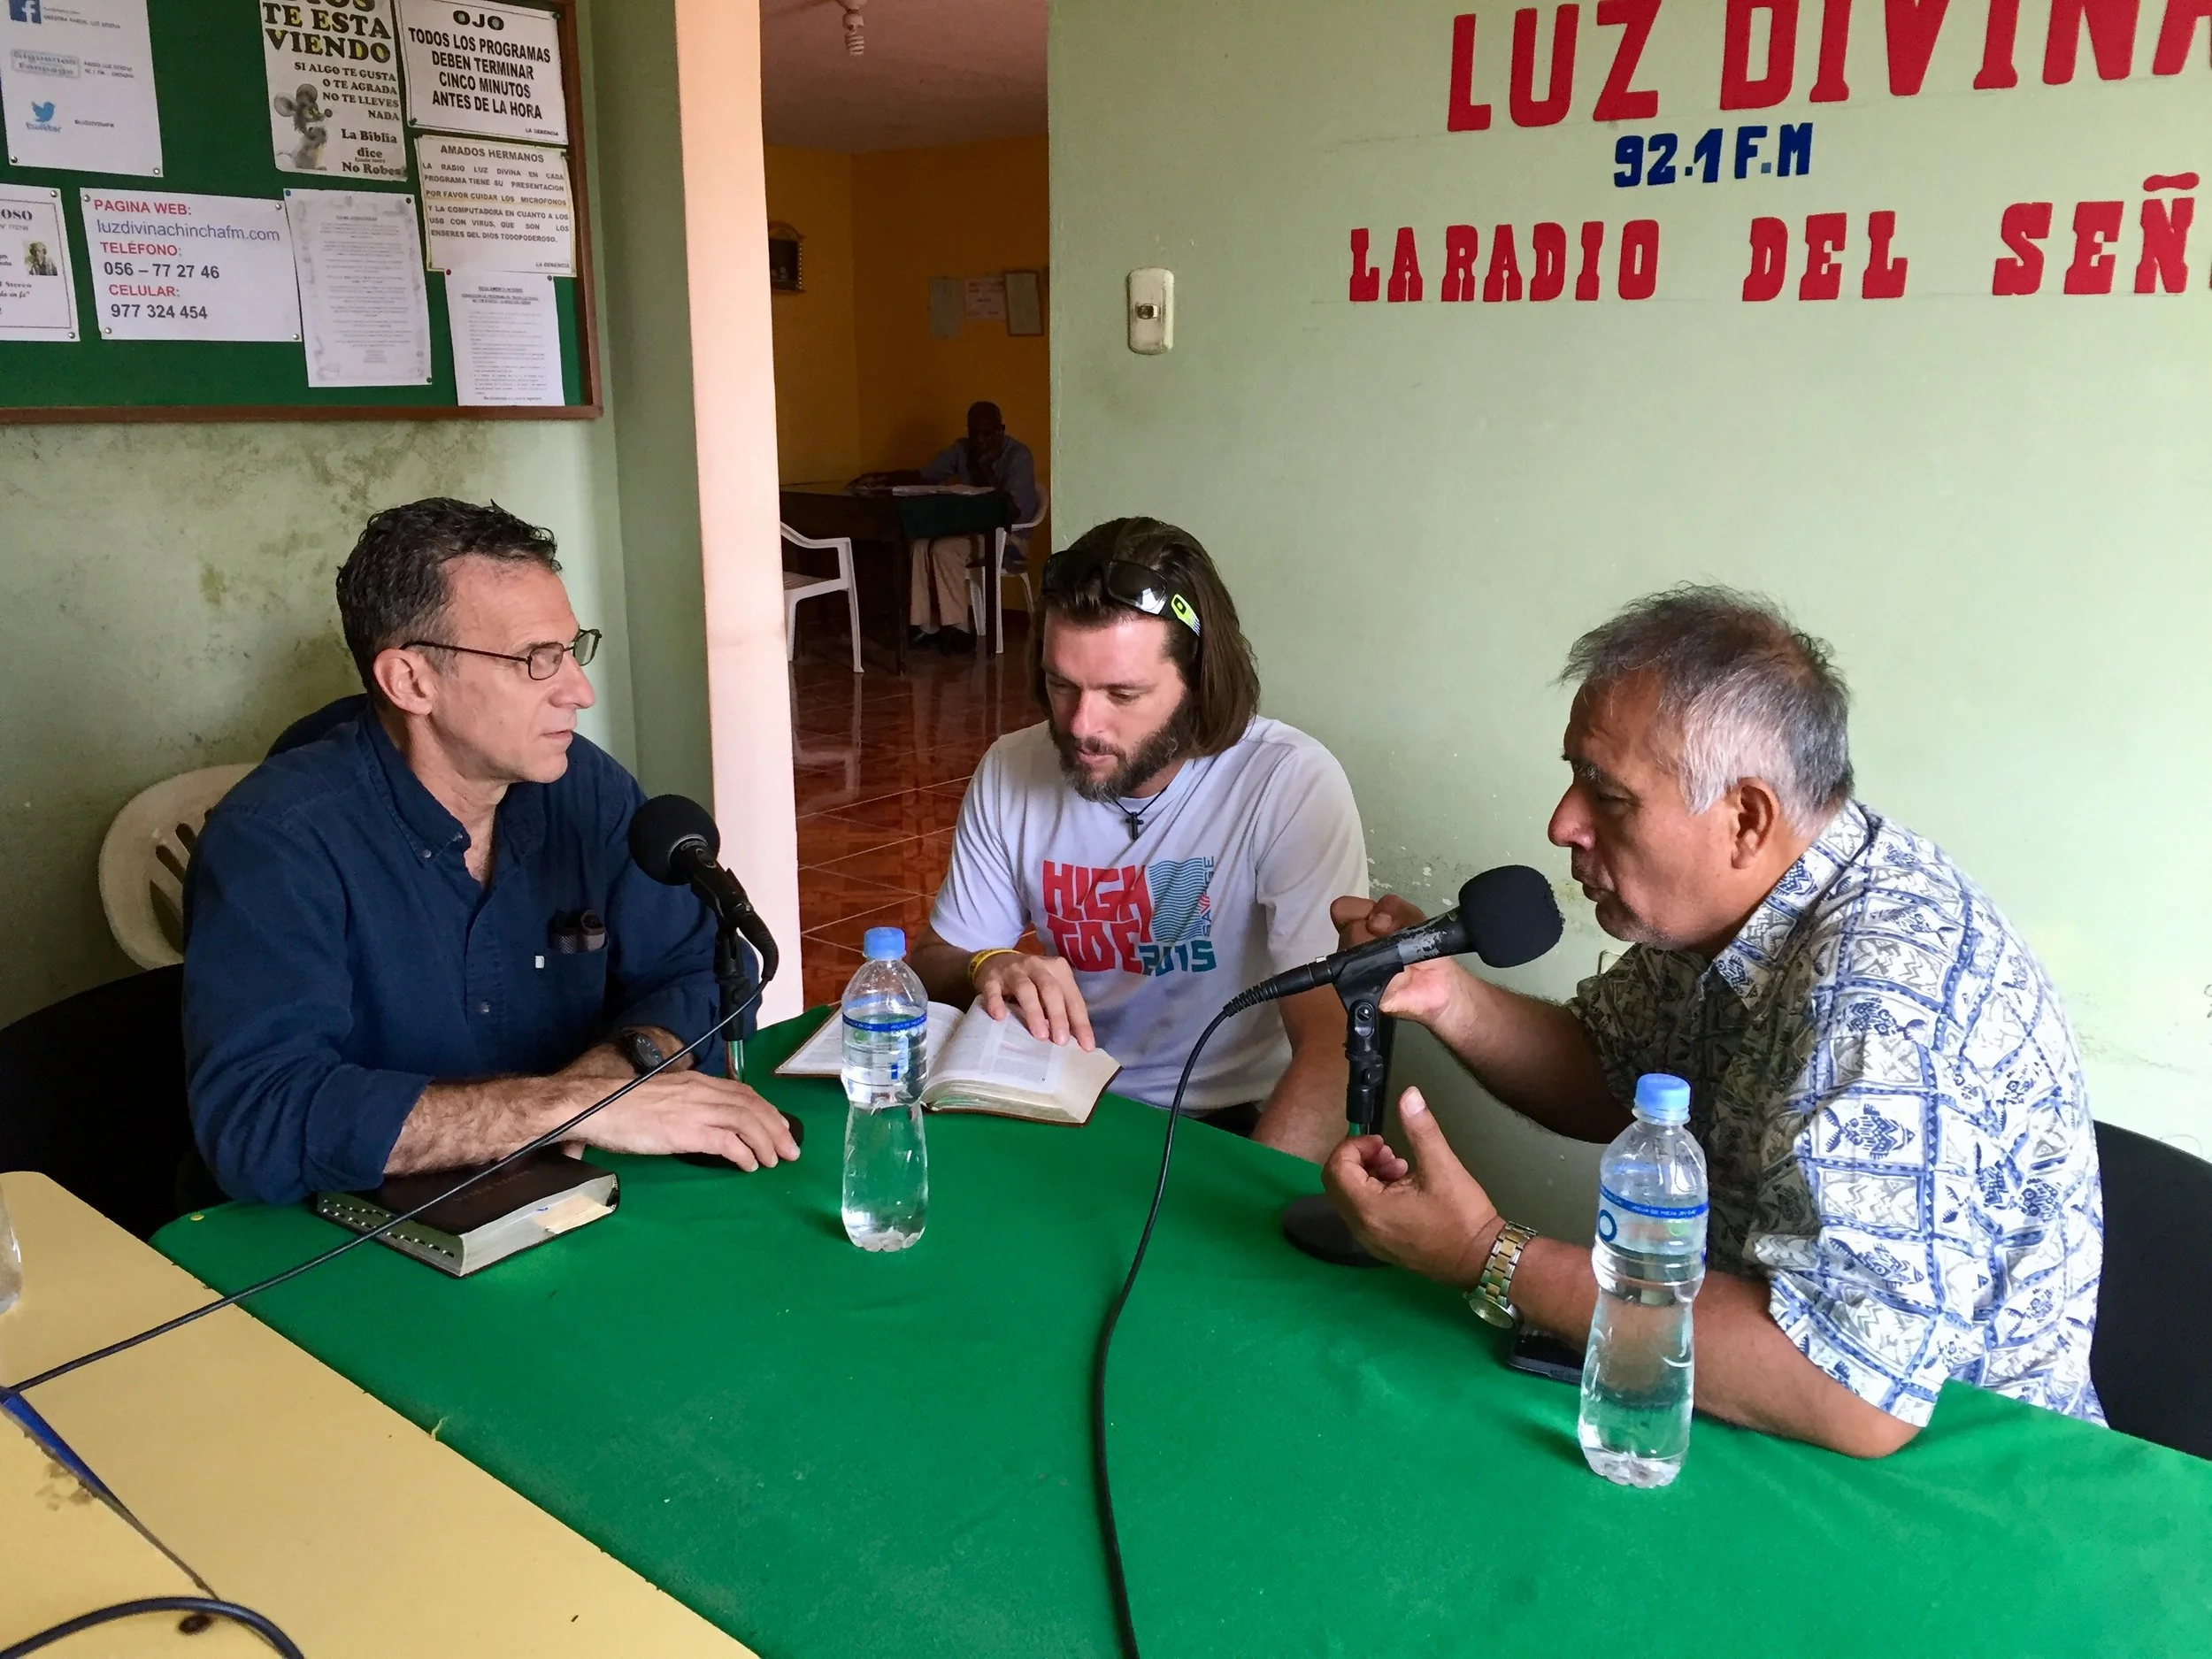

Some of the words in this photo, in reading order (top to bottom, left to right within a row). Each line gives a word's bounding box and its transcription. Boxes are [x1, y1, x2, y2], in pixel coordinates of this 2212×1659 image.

[262, 2, 303, 27] TE
[311, 8, 392, 39] ESTA
[452, 10, 504, 31] OJO
[265, 27, 391, 64] VIENDO
[408, 27, 449, 48] TODOS
[453, 34, 476, 52] LOS
[479, 38, 550, 63] PROGRAMAS
[294, 61, 306, 71] SI
[309, 64, 341, 74] ALGO
[342, 67, 357, 77] TE
[359, 70, 397, 81] GUSTA
[432, 50, 471, 71] DEBEN
[473, 57, 534, 80] TERMINAR
[1447, 0, 1663, 132] LUZ
[322, 78, 331, 87] O
[333, 79, 348, 89] TE
[350, 81, 398, 95] AGRADA
[439, 71, 476, 90] CINCO
[479, 77, 531, 99] MINUTOS
[322, 91, 340, 102] NO
[342, 93, 357, 103] TE
[357, 96, 399, 108] LLEVES
[432, 90, 472, 110] ANTES
[474, 96, 489, 112] DE
[492, 98, 507, 115] LA
[510, 101, 542, 119] HORA
[367, 110, 400, 121] NADA
[341, 127, 357, 140] La
[359, 130, 397, 144] Biblia
[357, 147, 383, 158] dice
[441, 144, 486, 157] AMADOS
[488, 149, 545, 164] HERMANOS
[1614, 127, 1724, 188] 92.1
[1733, 122, 1814, 180] F.M
[342, 161, 360, 173] No
[363, 163, 402, 175] Robes
[496, 168, 521, 177] DIVINA
[424, 174, 467, 185] PROGRAMA
[511, 181, 565, 192] PRESENTACION
[94, 199, 150, 214] PAGINA
[154, 202, 192, 216] WEB:
[442, 190, 469, 199] FAVOR
[470, 192, 498, 201] CUIDAR
[520, 196, 567, 207] MICROFONOS
[447, 206, 503, 216] COMPUTADORA
[96, 219, 280, 242] luzdivinachinchafm.com
[1349, 227, 1423, 303] LA
[1440, 219, 1660, 303] RADIO
[1741, 211, 1909, 303] DEL
[1992, 172, 2212, 296] SEÑ
[104, 262, 134, 276] 056
[152, 263, 171, 278] 77
[177, 264, 195, 278] 27
[201, 265, 220, 280] 46
[109, 284, 180, 297] CELULAR:
[111, 303, 141, 318] 977
[146, 303, 175, 319] 324
[180, 305, 208, 319] 454
[1042, 860, 1152, 942] HIGH
[1138, 940, 1217, 977] 2015
